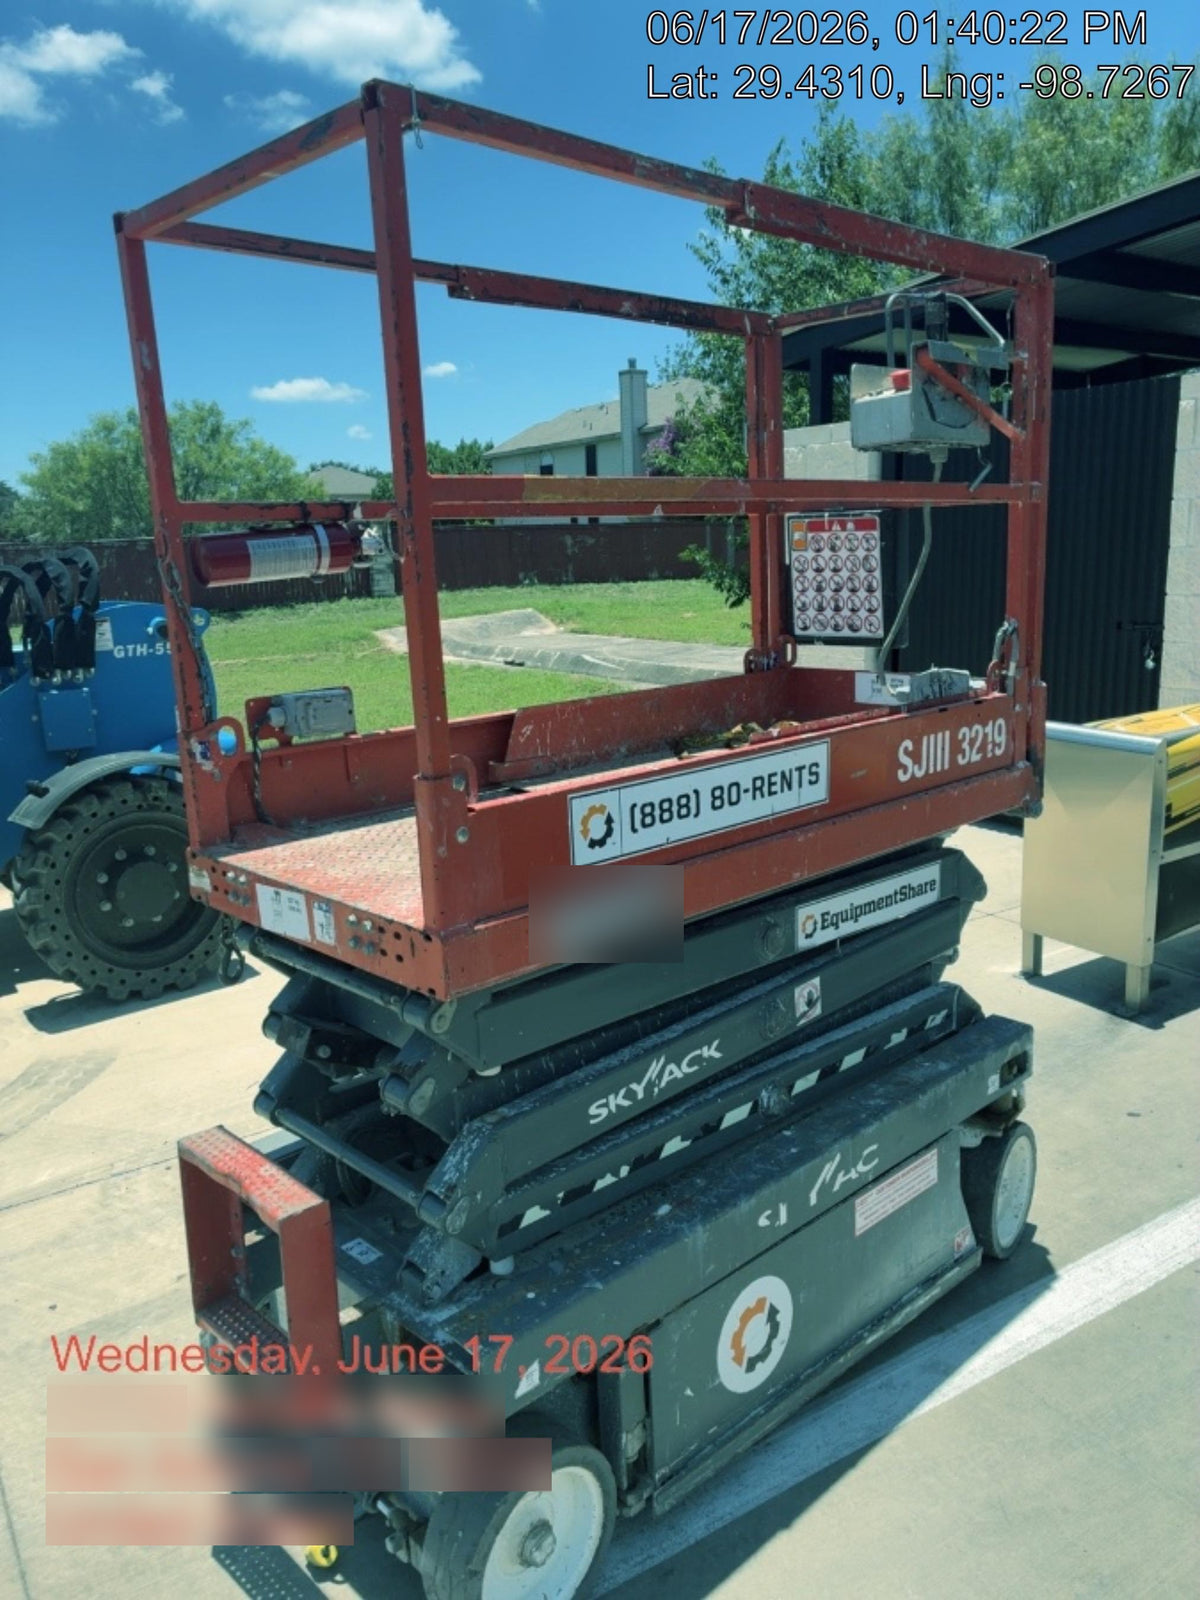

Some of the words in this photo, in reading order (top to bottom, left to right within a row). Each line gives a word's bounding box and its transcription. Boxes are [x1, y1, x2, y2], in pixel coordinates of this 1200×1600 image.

[897, 730, 950, 782] SJIII
[957, 718, 1007, 766] 3219
[630, 788, 701, 833] (888)
[711, 761, 821, 811] 80-RENTS
[820, 878, 937, 930] EquipmentShare
[588, 1038, 724, 1125] SKYJACK
